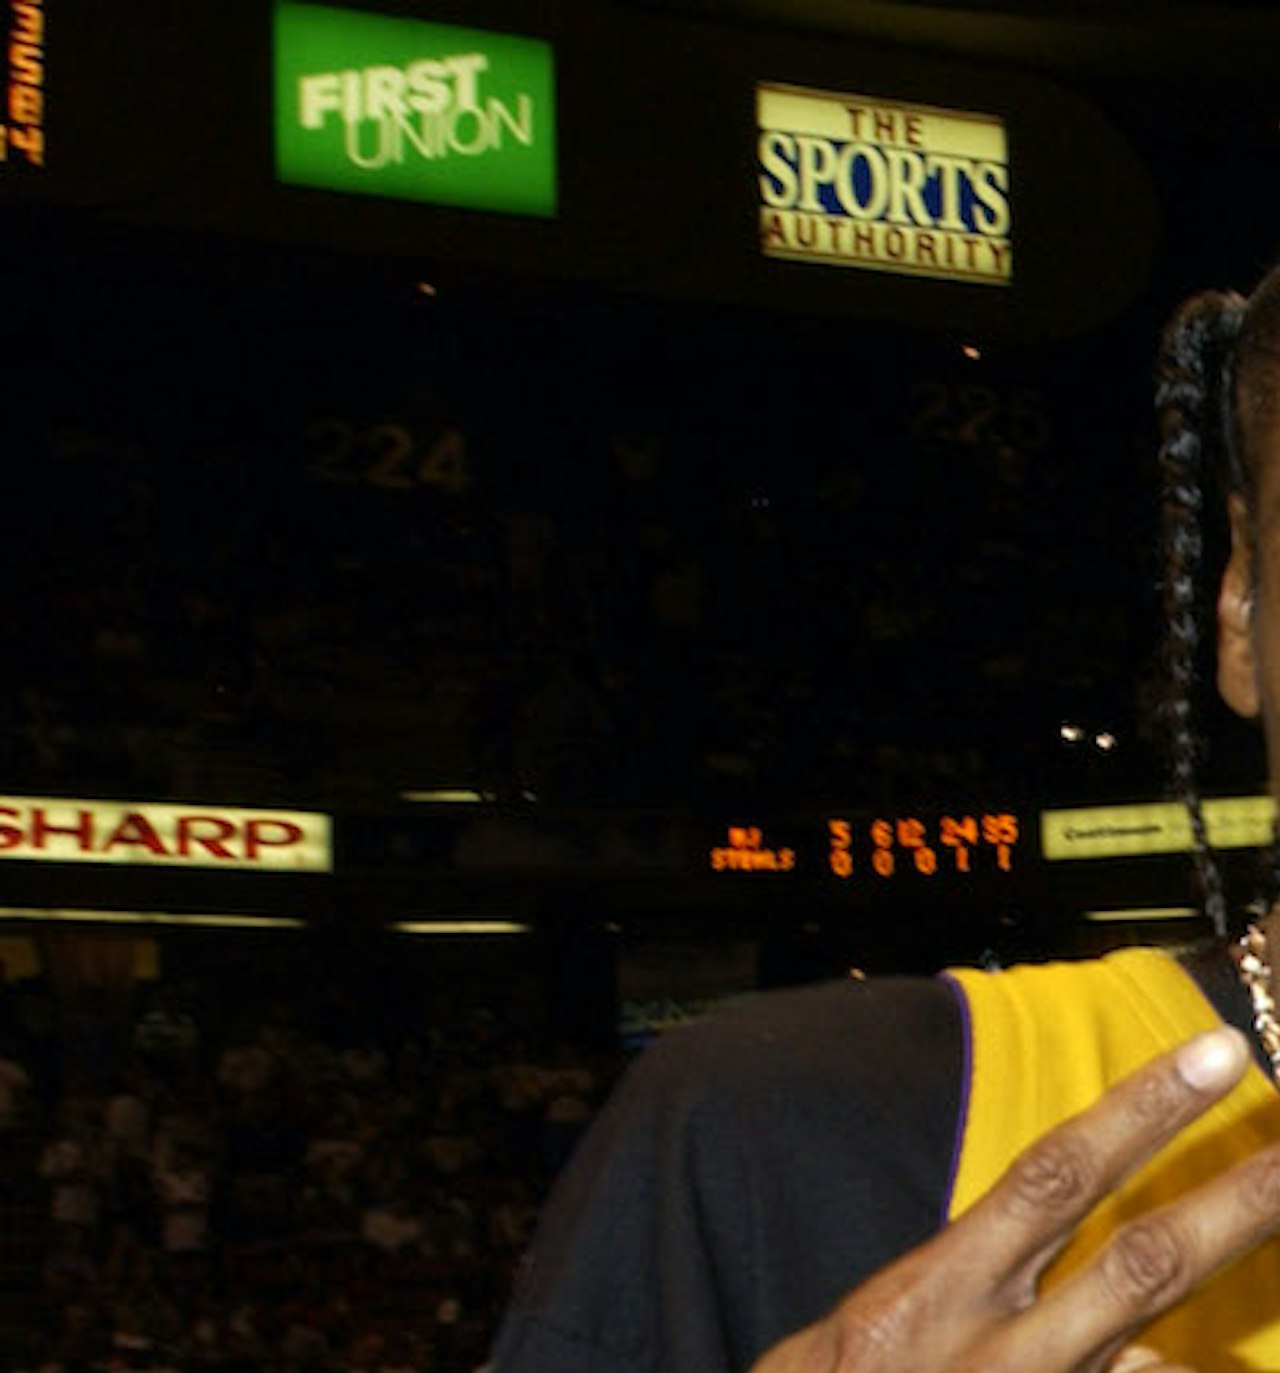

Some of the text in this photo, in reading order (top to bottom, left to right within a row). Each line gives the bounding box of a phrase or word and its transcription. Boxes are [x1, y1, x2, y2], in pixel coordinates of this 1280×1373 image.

[299, 53, 488, 130] FIRST
[846, 107, 924, 146] THE
[346, 93, 533, 170] UNION
[758, 132, 1010, 238] SPORTS
[764, 213, 1012, 274] AUTHORITY
